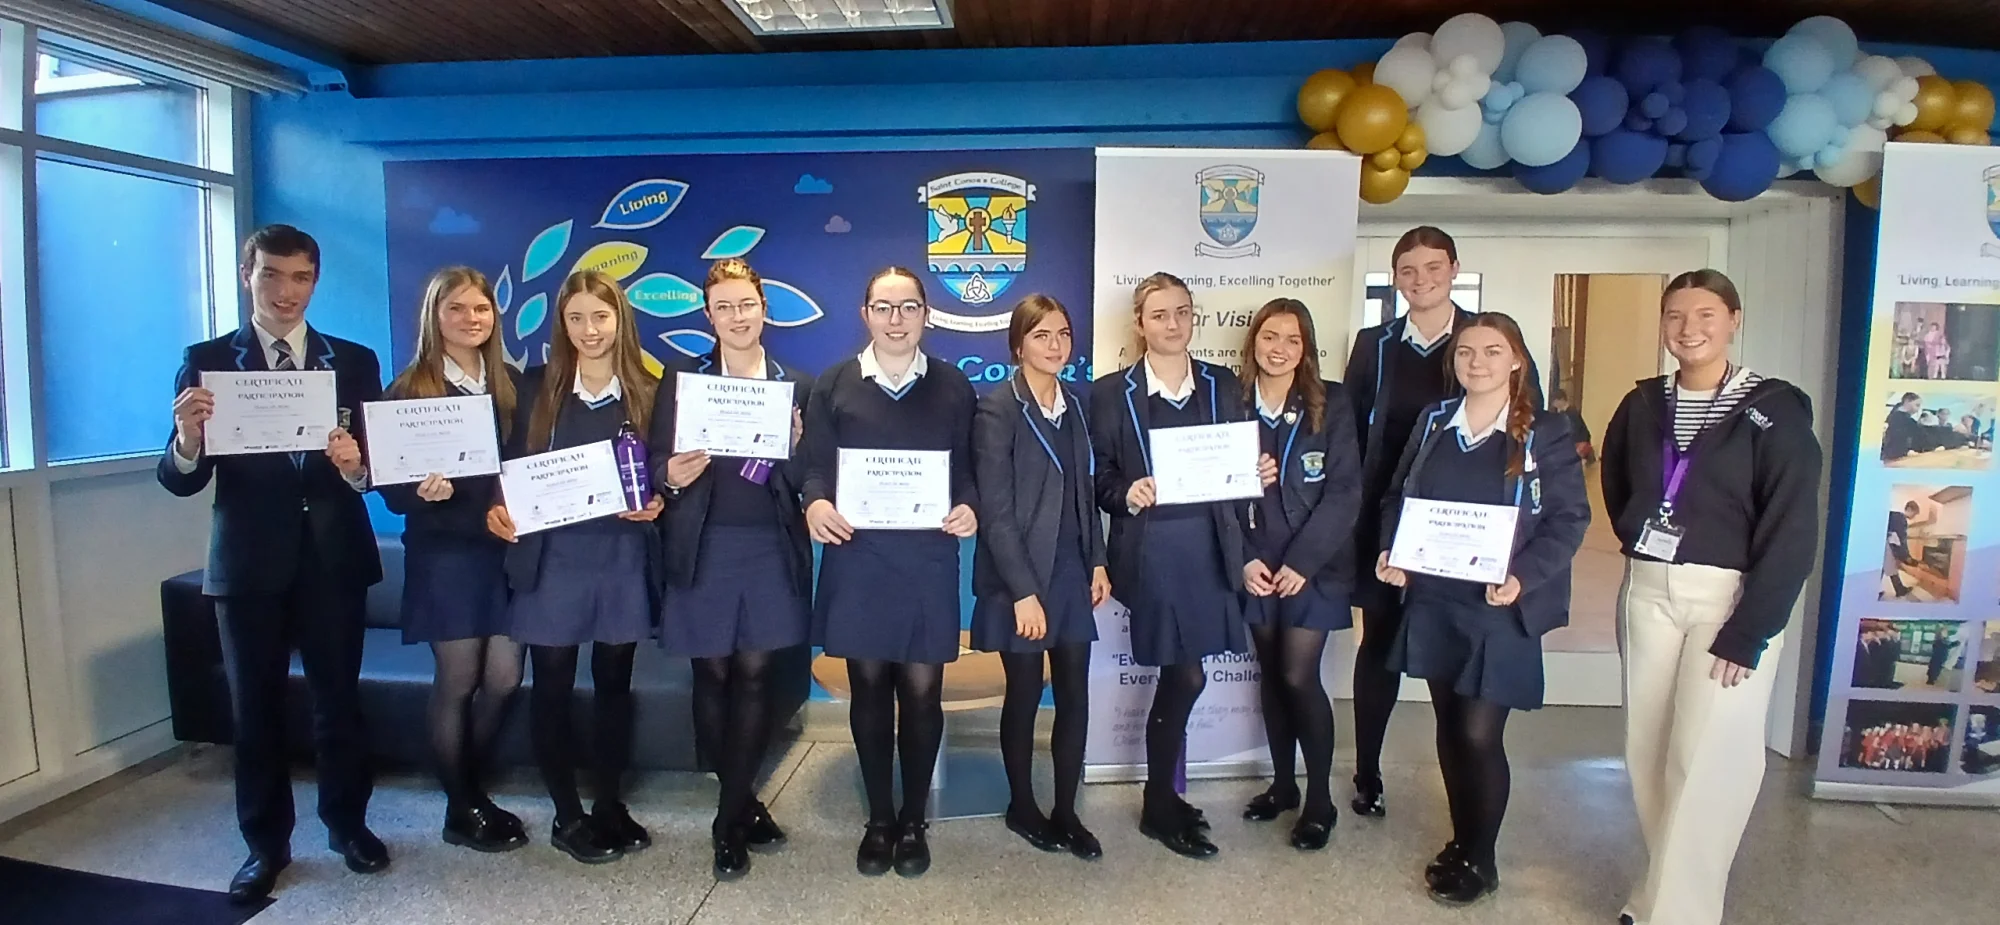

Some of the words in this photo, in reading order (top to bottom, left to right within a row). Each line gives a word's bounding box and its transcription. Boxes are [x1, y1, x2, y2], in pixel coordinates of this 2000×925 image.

[930, 182, 951, 193] Saint
[990, 178, 1022, 189] College
[619, 190, 669, 215] Living
[580, 250, 639, 273] arning
[1182, 274, 1216, 287] rning,
[1219, 275, 1275, 288] Excelling
[1278, 275, 1336, 288] Together'
[634, 289, 698, 302] Excelling
[1216, 310, 1253, 328] Visi
[1217, 349, 1237, 358] are
[236, 378, 303, 388] CERTIFICATE
[707, 383, 767, 395] CERTIFICATE
[396, 404, 461, 416] CERTIFICATE
[527, 452, 585, 470] CERTIFICATE
[1213, 669, 1262, 683] Challe
